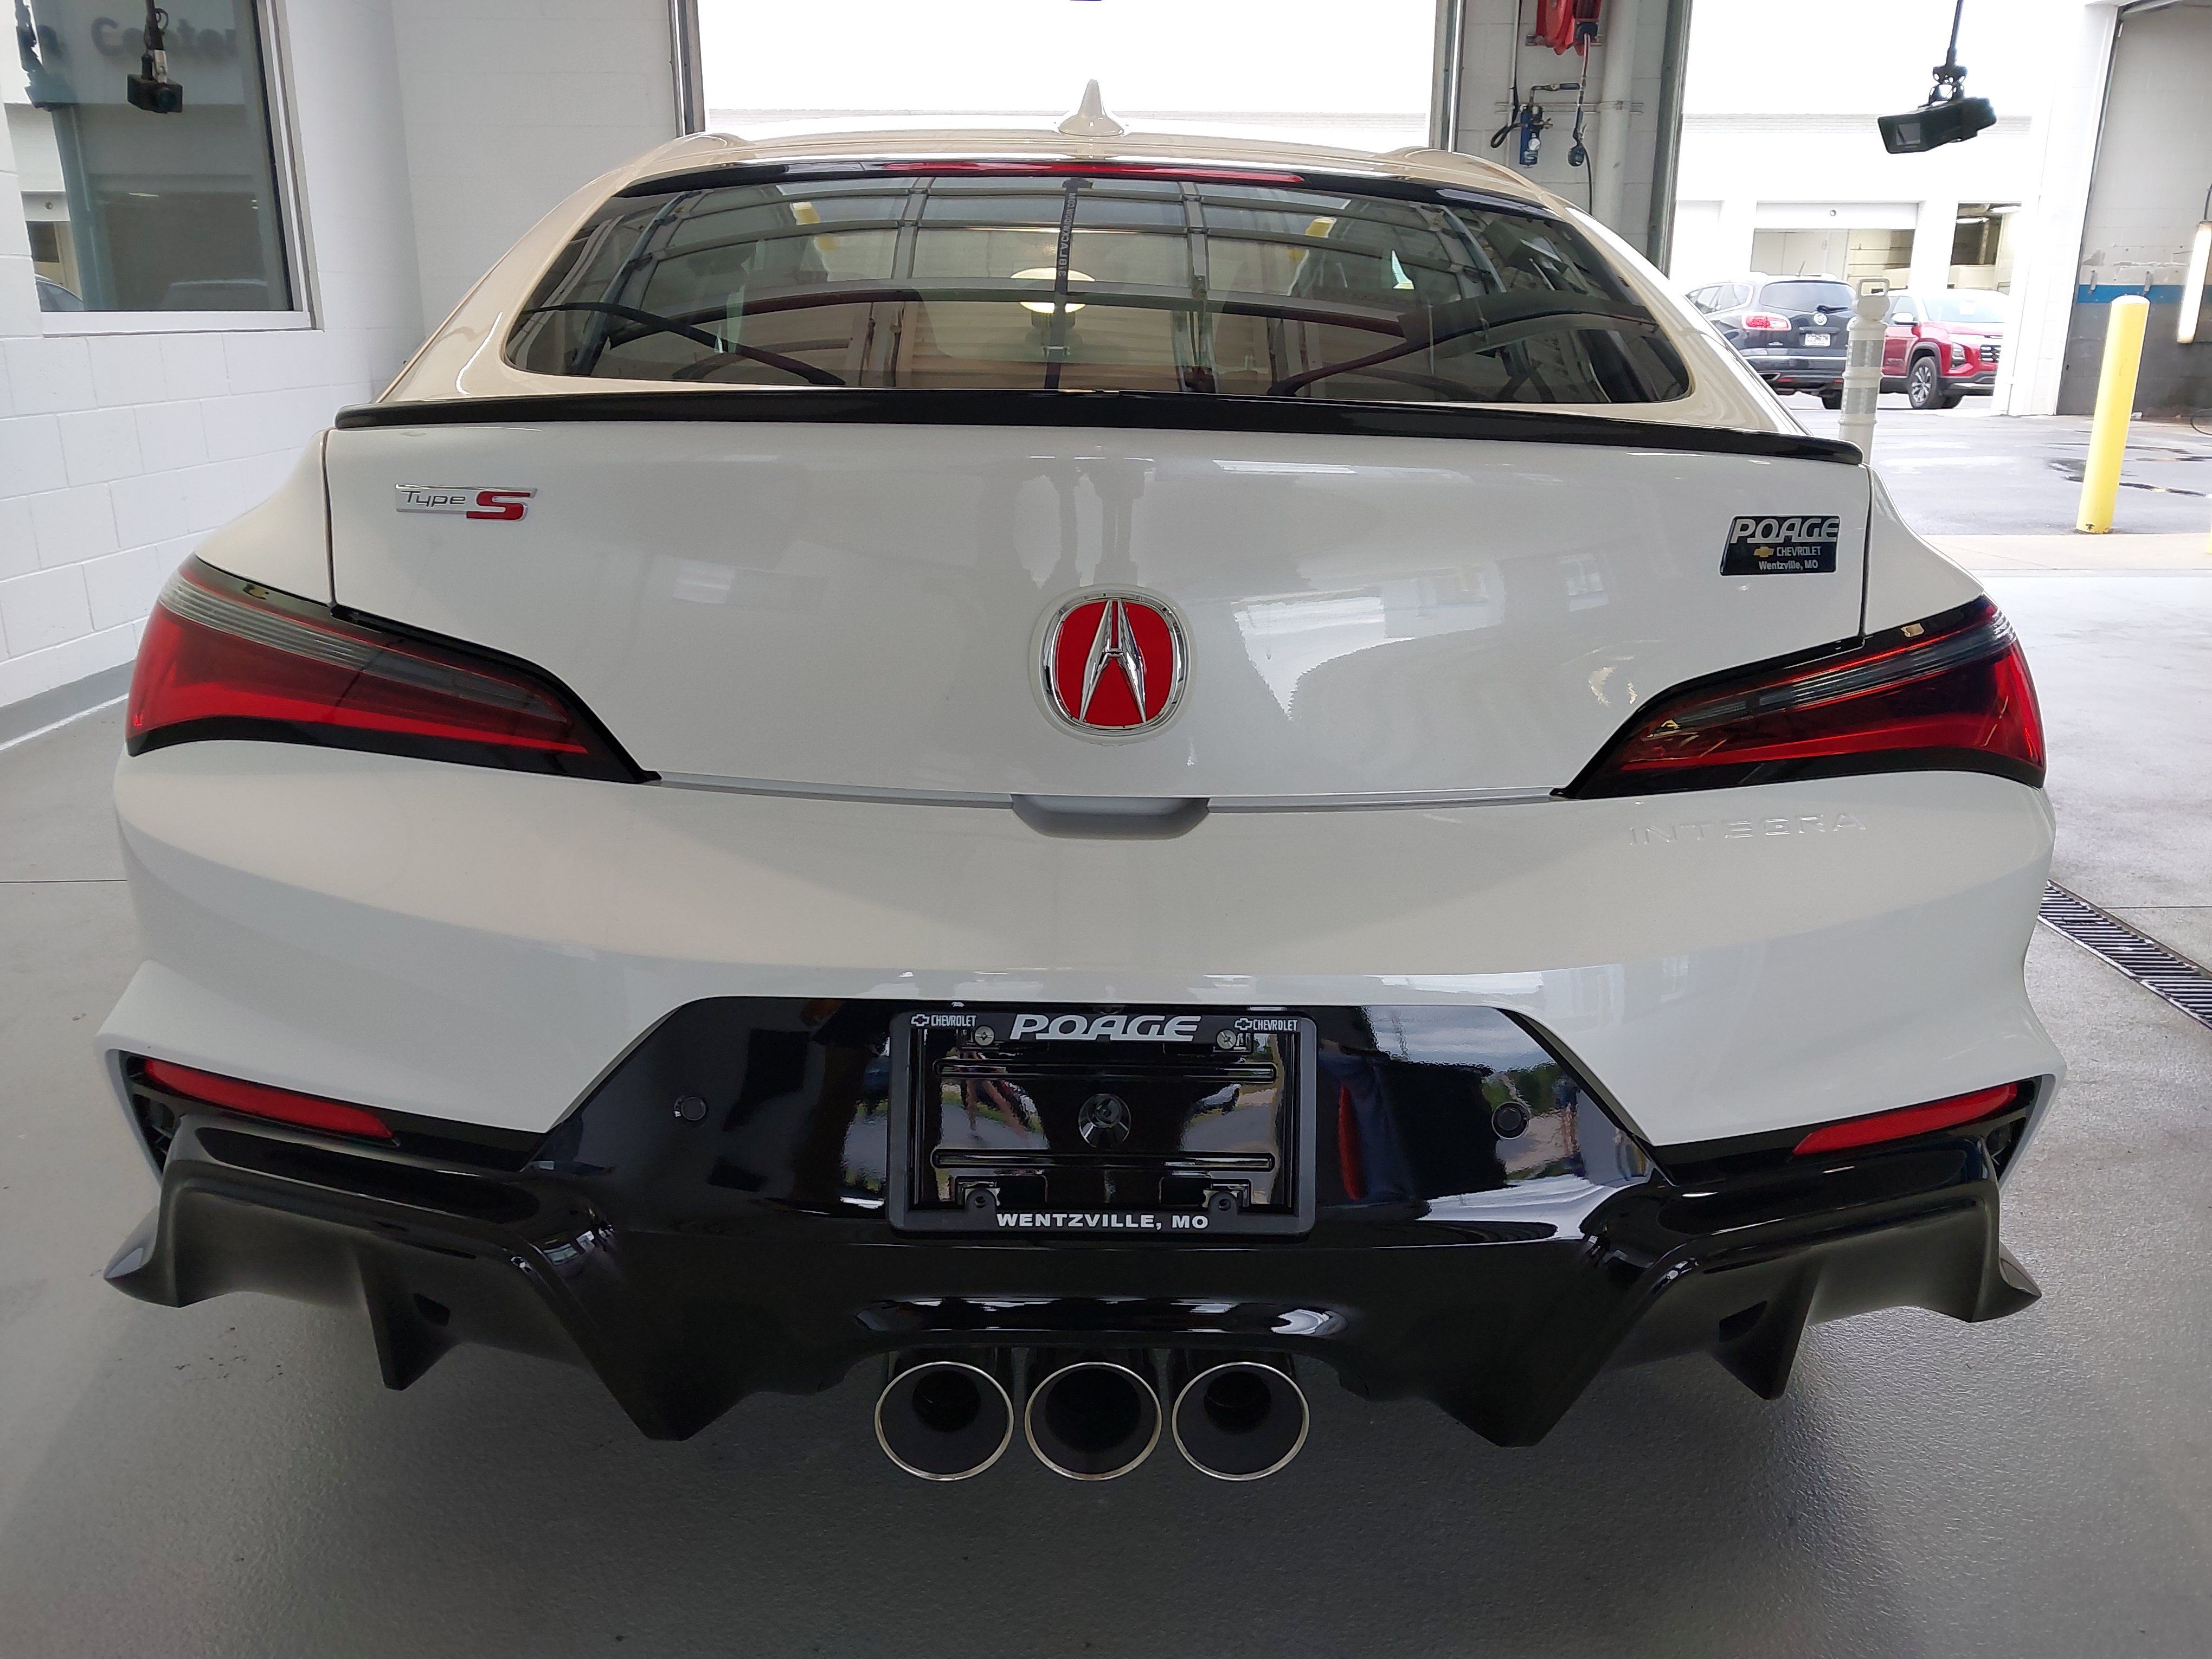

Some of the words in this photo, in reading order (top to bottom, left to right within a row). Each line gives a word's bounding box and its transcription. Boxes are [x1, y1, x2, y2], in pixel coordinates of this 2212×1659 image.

[401, 490, 466, 507] Type
[466, 490, 532, 521] S
[1730, 518, 1840, 544] POAGE
[1776, 546, 1822, 557] CHEVROLET
[1758, 560, 1804, 570] Wentzville,
[1804, 559, 1818, 569] MO
[1629, 813, 1866, 846] INTEGRA
[931, 1014, 977, 1027] CHEVROLET
[1009, 1014, 1202, 1041] POAGE
[1252, 1019, 1298, 1031] CHEVROLET
[996, 1213, 1163, 1231] WENTZVILLE,
[1171, 1214, 1209, 1229] MO
